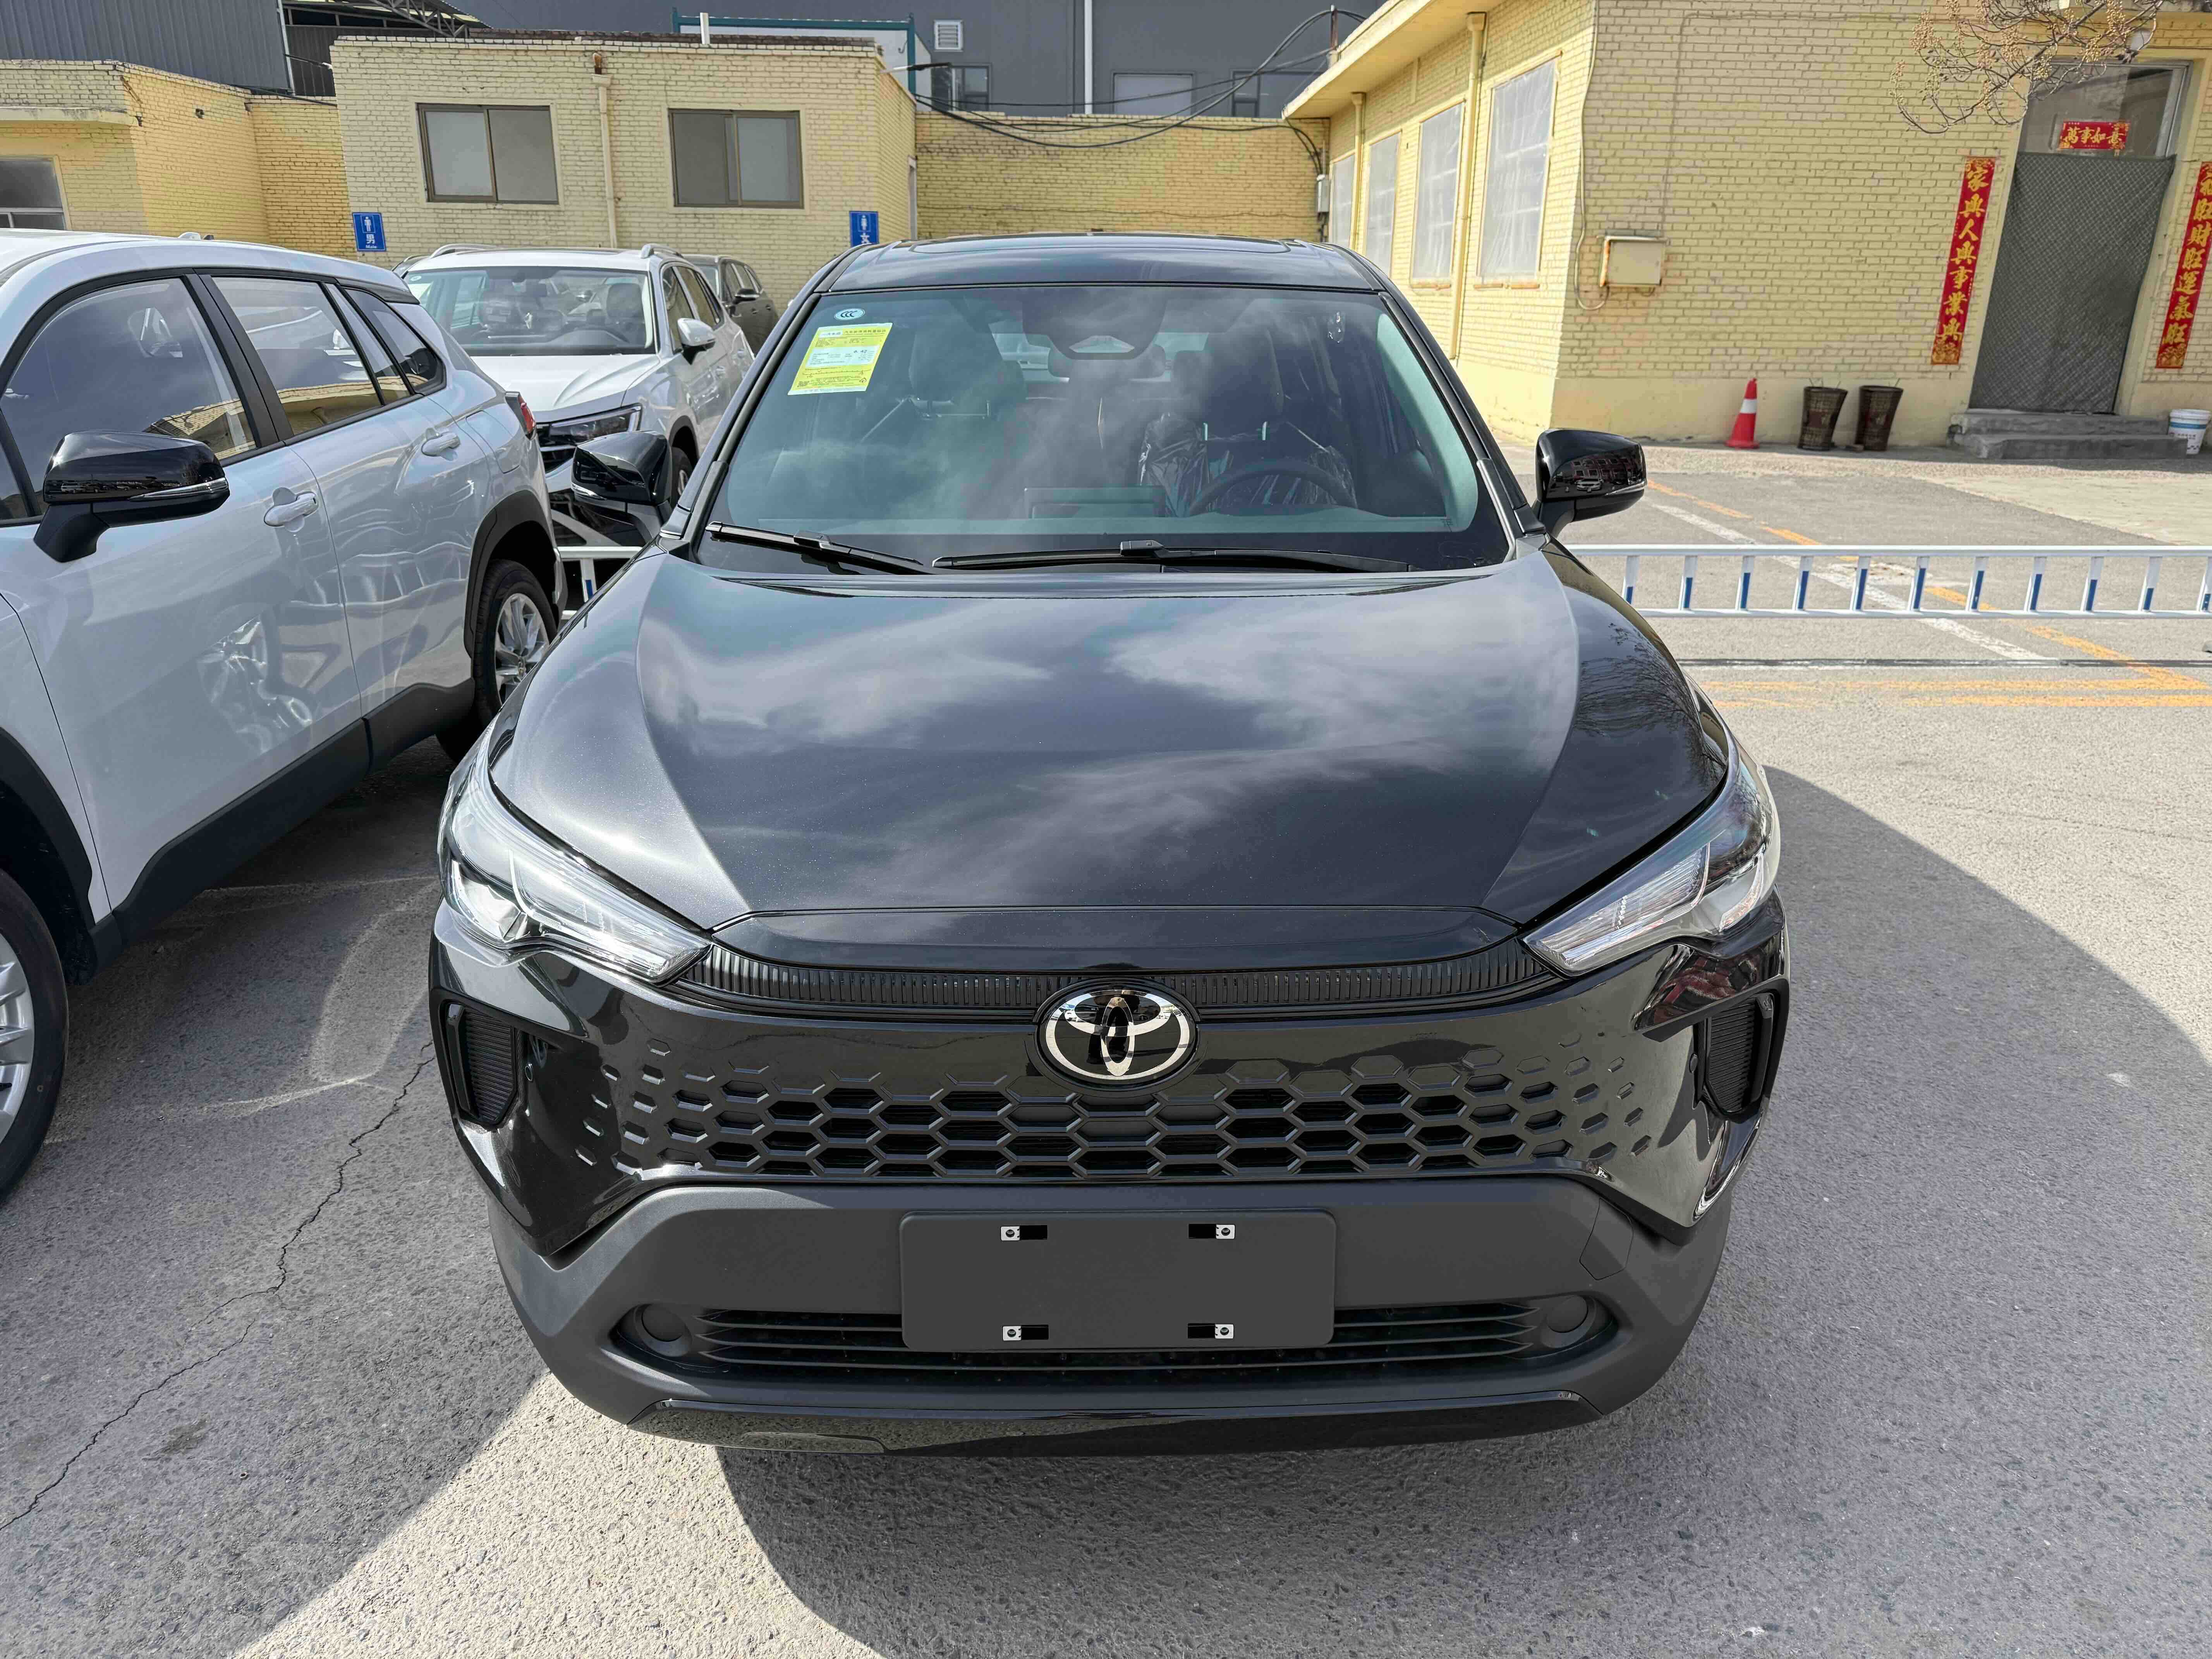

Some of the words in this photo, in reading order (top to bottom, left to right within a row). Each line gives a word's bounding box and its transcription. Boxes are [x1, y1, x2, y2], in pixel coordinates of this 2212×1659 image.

[2063, 127, 2124, 144] 萬事如意
[366, 234, 375, 244] 男
[860, 232, 870, 244] 女
